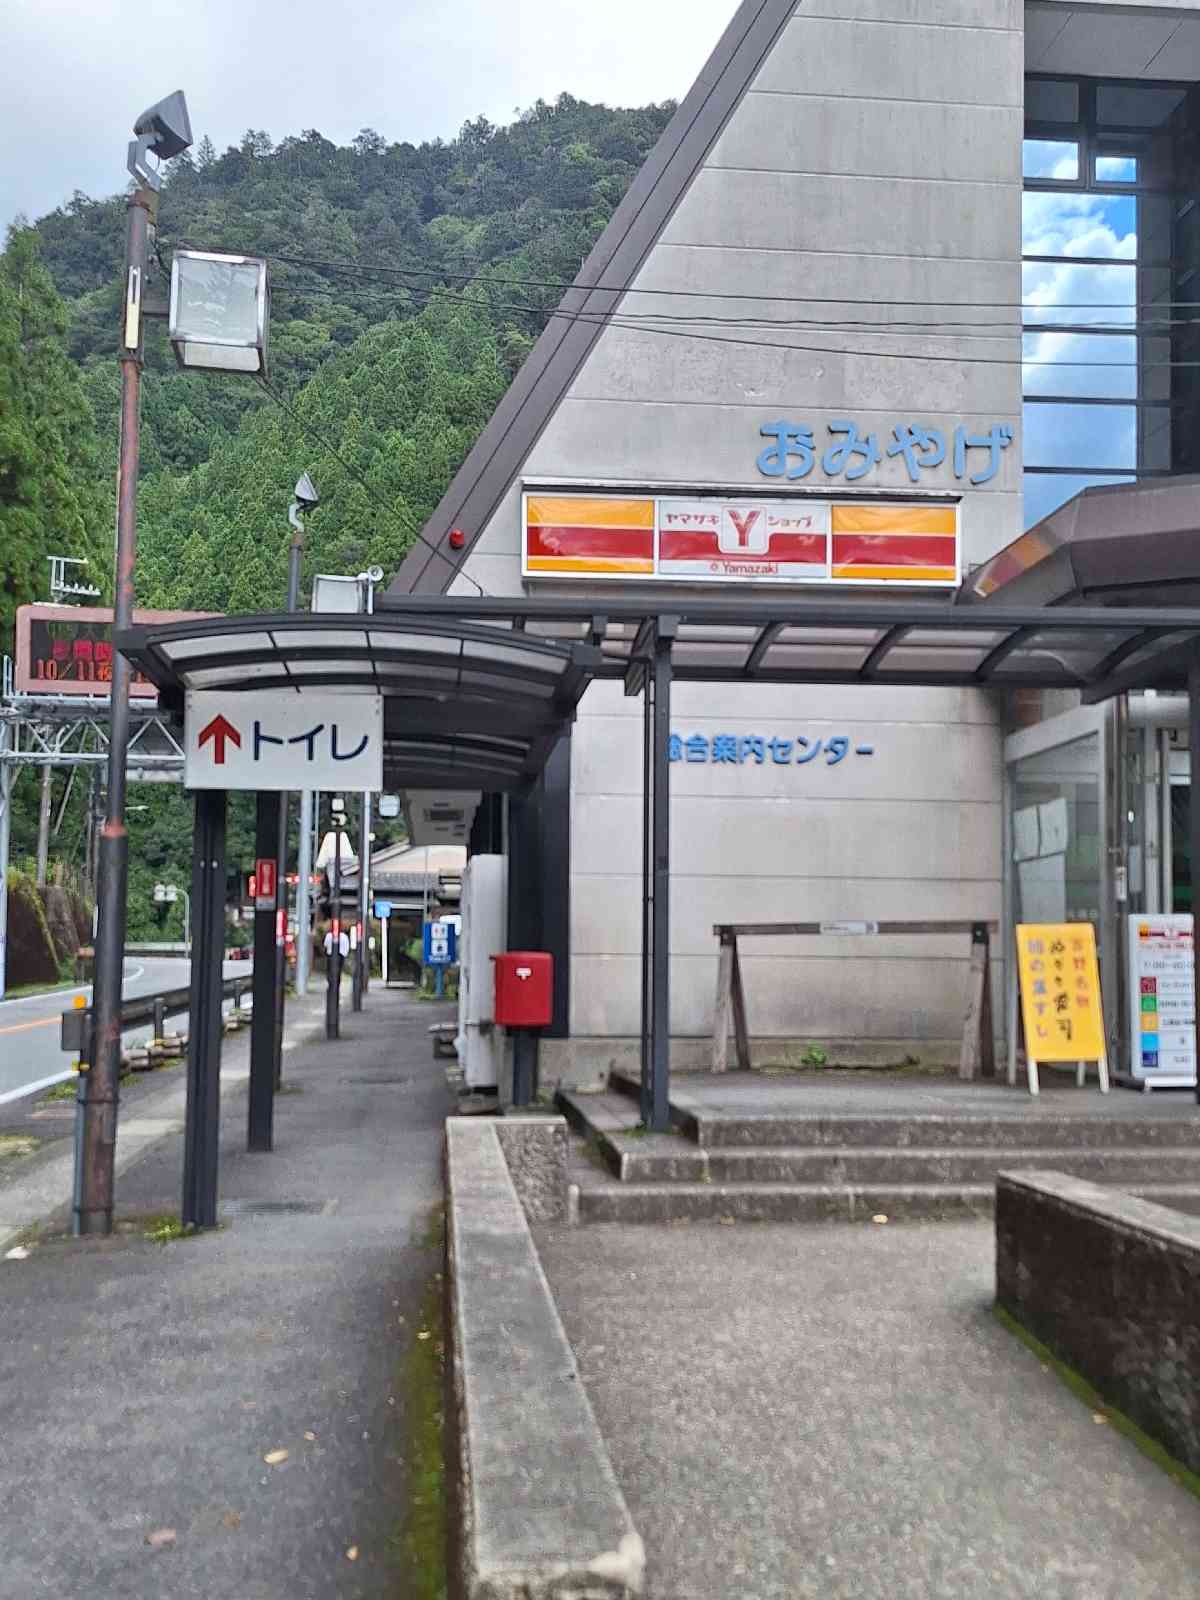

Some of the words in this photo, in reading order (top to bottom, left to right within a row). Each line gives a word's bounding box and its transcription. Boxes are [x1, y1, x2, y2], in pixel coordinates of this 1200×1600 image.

[756, 419, 1013, 485] おみやげ
[727, 510, 761, 547] Y
[767, 515, 813, 528] ショップ
[722, 560, 778, 574] Yamazaki
[254, 720, 368, 761] トイレ
